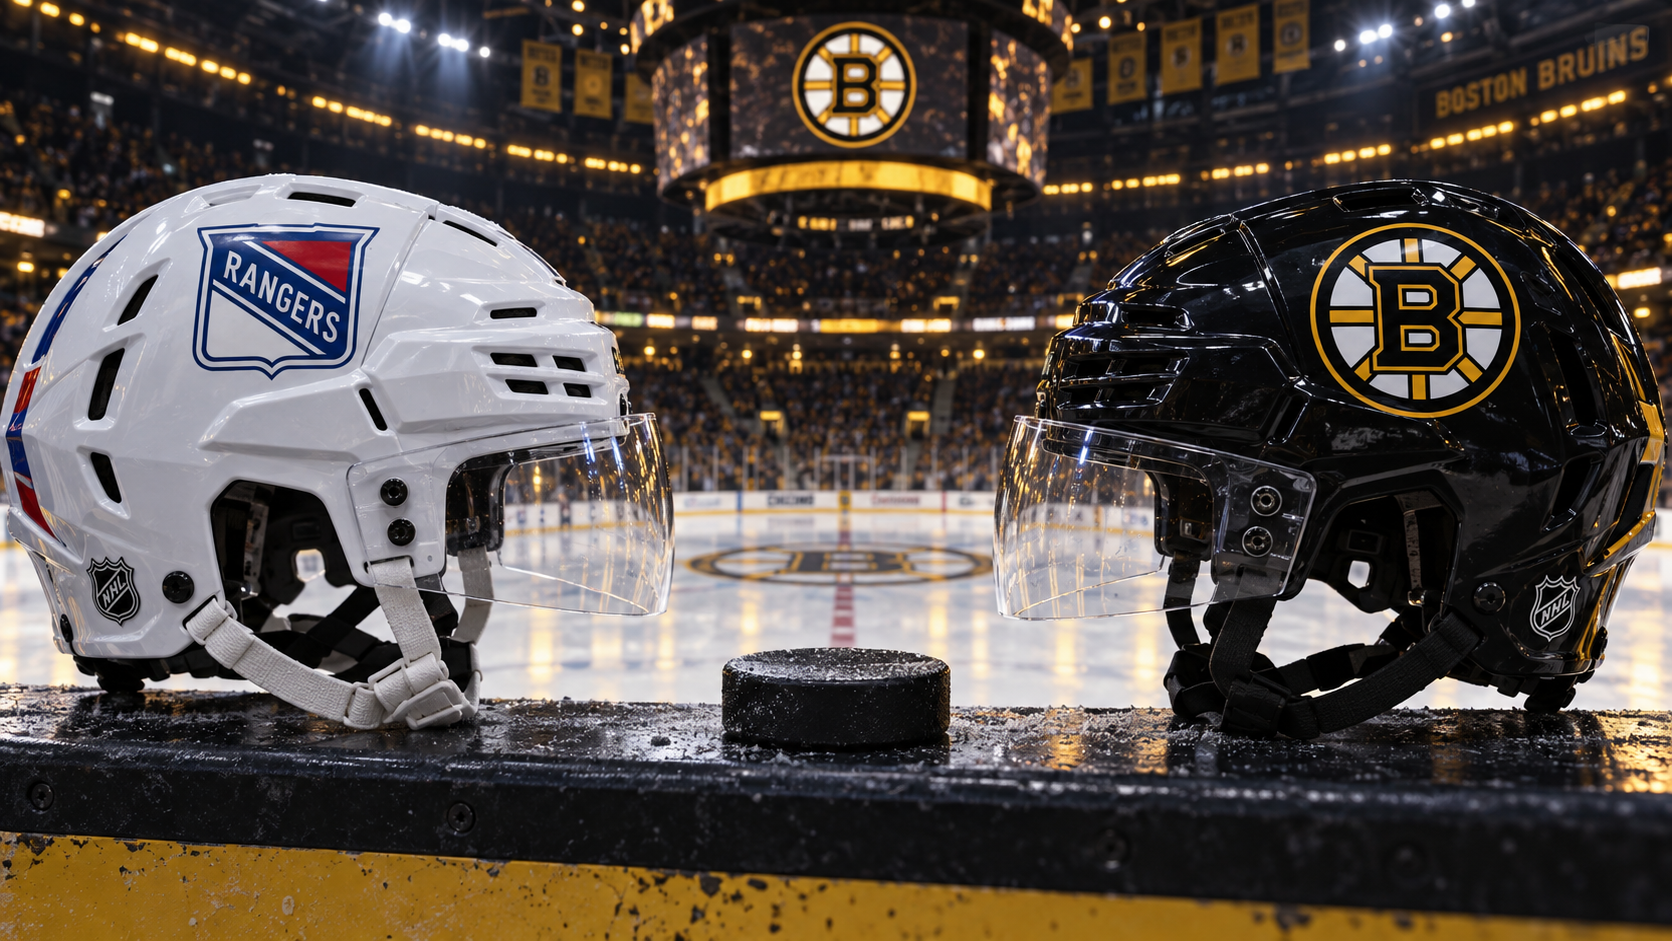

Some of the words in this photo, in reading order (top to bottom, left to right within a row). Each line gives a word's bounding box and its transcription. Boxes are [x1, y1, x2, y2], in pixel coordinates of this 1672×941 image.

[831, 53, 882, 117] B
[1435, 66, 1528, 119] BOSTON
[1537, 26, 1650, 91] BRUINS
[222, 250, 340, 343] RANGERS
[1368, 265, 1464, 372] B
[102, 575, 127, 609] NHL
[1540, 593, 1570, 626] NHL
